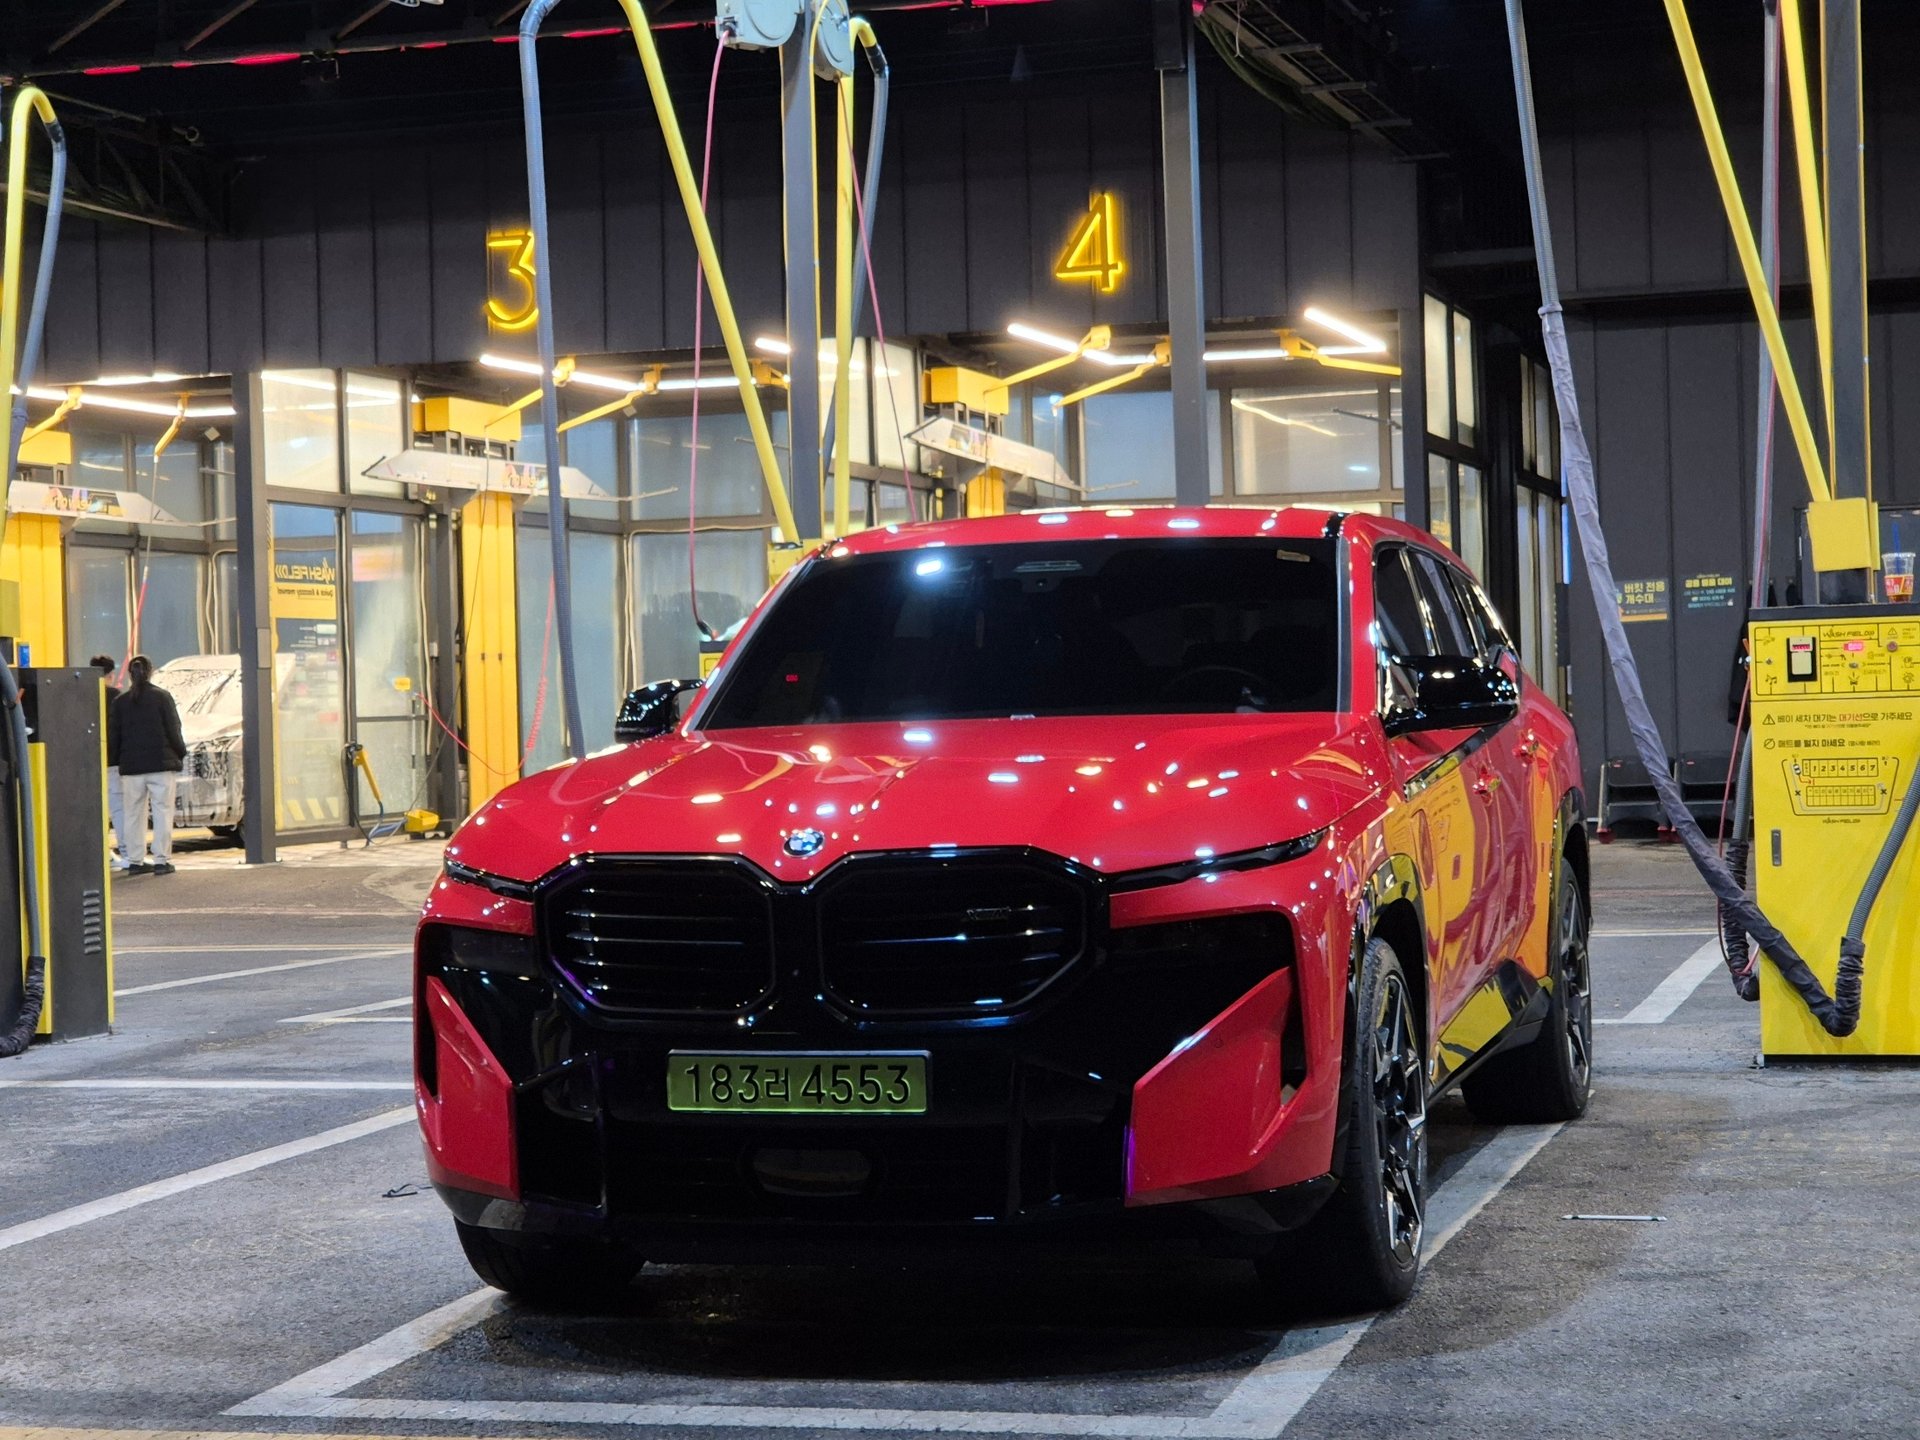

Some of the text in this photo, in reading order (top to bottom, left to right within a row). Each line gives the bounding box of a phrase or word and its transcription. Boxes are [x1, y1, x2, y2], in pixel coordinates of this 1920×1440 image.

[1056, 192, 1123, 290] 4
[484, 229, 538, 330] 3
[1823, 628, 1846, 638] WASH
[1777, 711, 1913, 723] 베이 세차 대기는 대기선으로 가주세요
[1821, 738, 1846, 748] 마세요
[685, 1063, 911, 1105] 183러 4553
